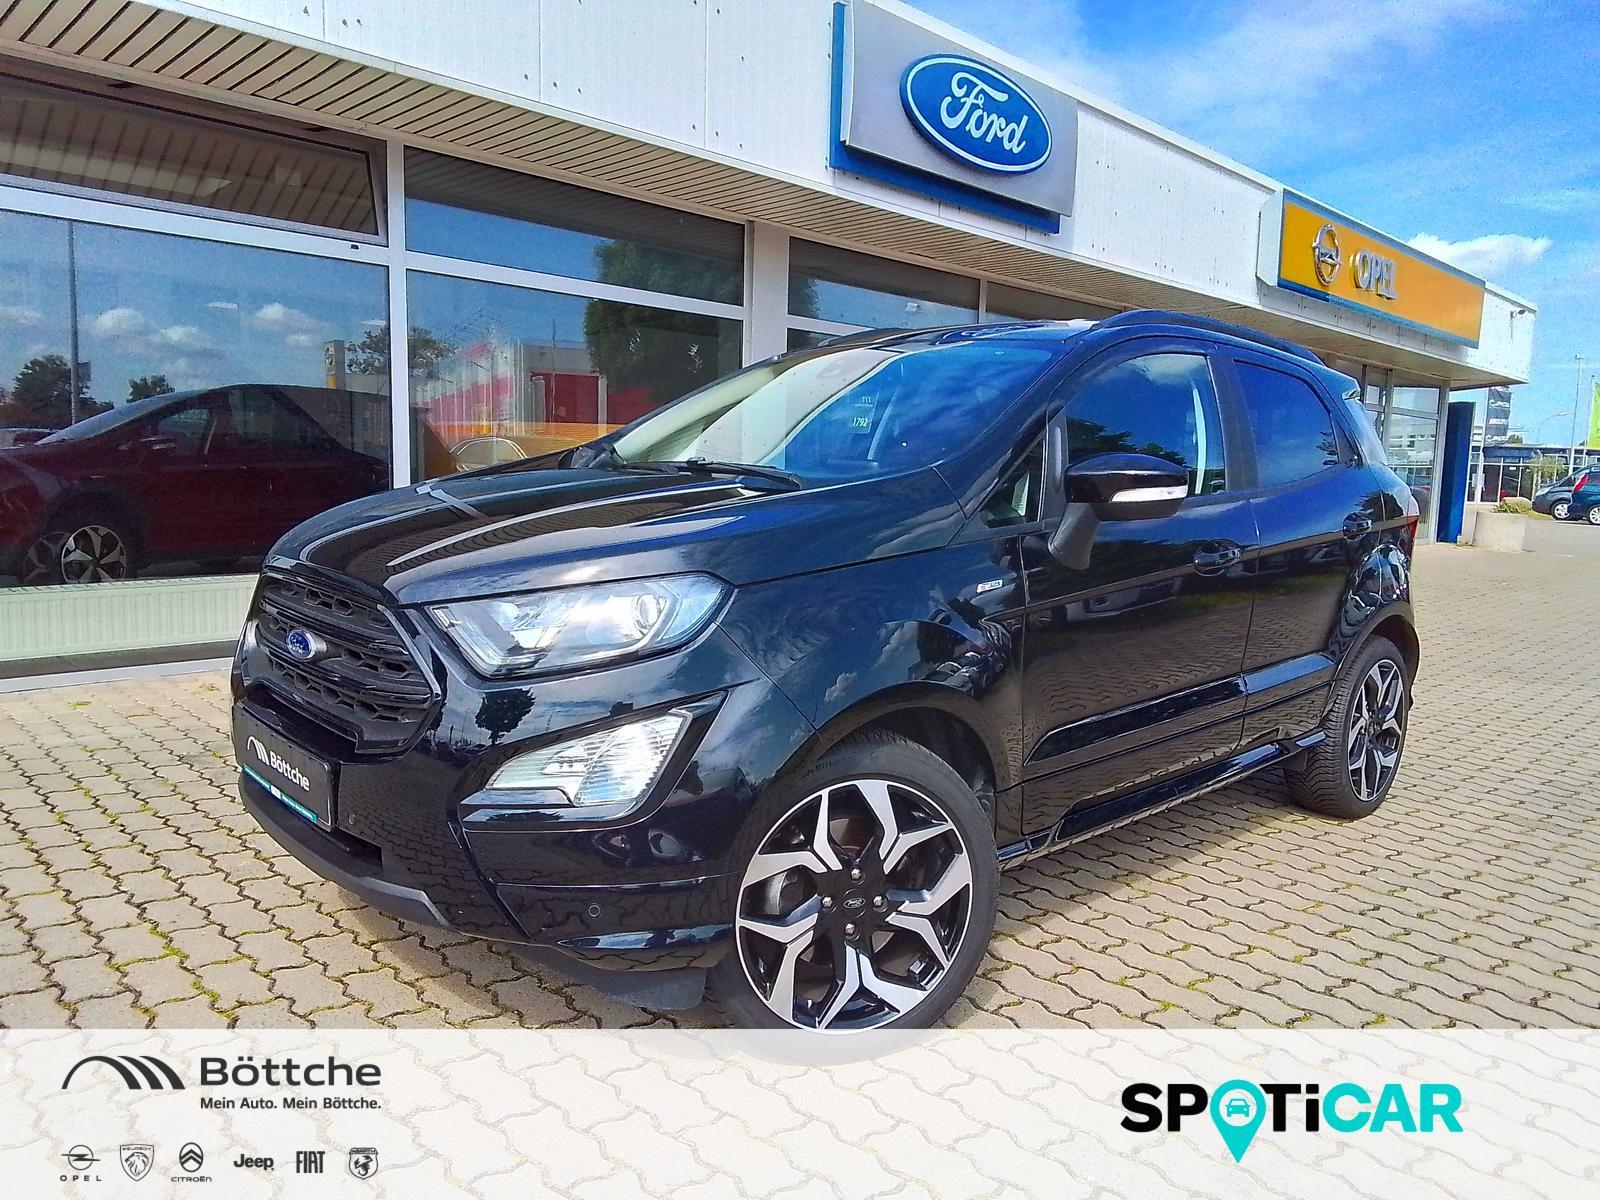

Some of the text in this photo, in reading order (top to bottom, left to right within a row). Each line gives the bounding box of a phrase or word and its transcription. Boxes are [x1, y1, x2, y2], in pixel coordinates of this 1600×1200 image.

[940, 71, 1028, 154] Ford
[1356, 249, 1396, 298] OPEL
[269, 750, 310, 791] Böttche
